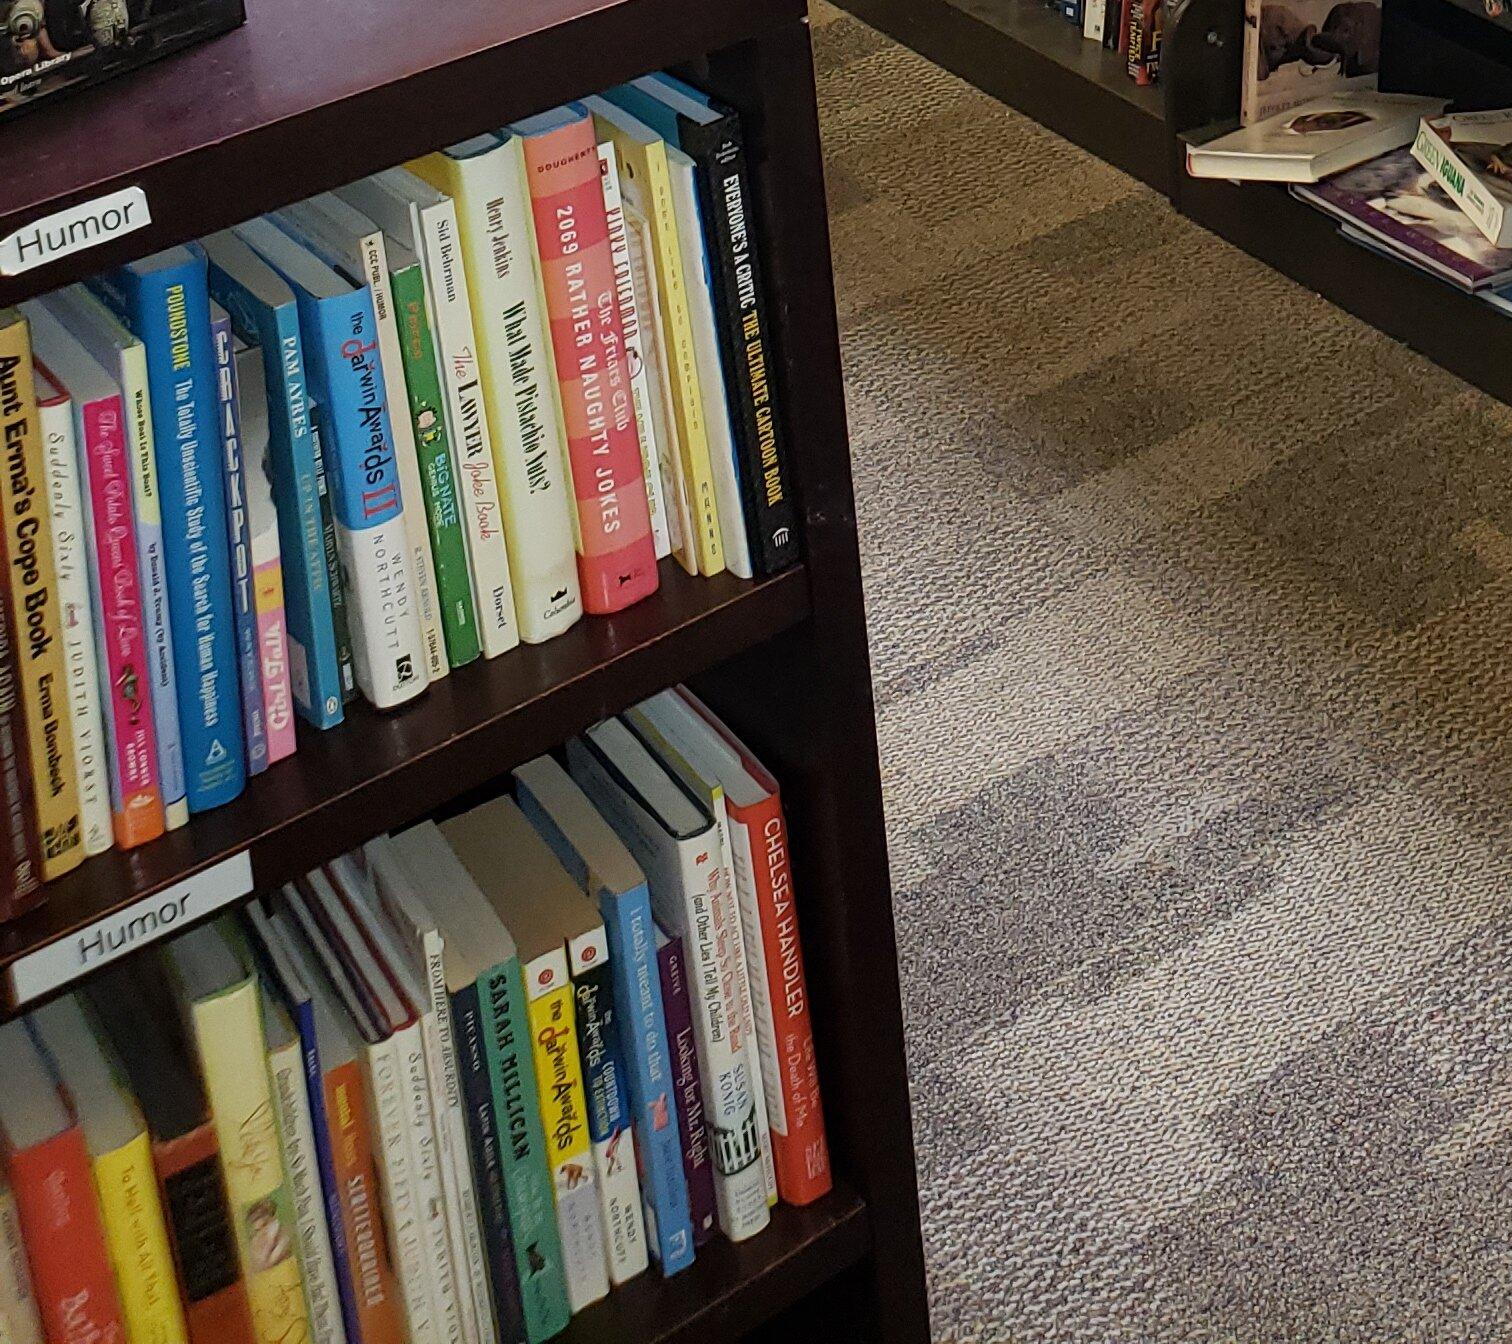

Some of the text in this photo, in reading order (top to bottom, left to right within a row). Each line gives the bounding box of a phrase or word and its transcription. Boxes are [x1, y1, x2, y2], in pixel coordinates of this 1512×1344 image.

[537, 145, 597, 173] DOUGHERTY
[1440, 158, 1466, 196] IGUANA
[16, 201, 134, 263] Humor
[723, 174, 746, 252] EVERYONE'S
[437, 219, 457, 304] Sid Behrman
[738, 264, 757, 309] CRITIC
[166, 284, 191, 372] POUNDSTONE
[744, 310, 760, 338] THE
[284, 336, 308, 438] PAM AYRES
[556, 205, 620, 534] 2069 RATHER NAUGHTY JOKES
[747, 338, 771, 403] ULTIMATE
[457, 378, 491, 542] LAWYER Joke Book
[515, 384, 552, 496] Pistachio Nuts?
[757, 404, 780, 466] CARTOON
[0, 355, 53, 659] Aunt Erma's Cope Book
[767, 468, 784, 507] BOOK
[44, 716, 66, 798] Bombeck
[78, 892, 192, 965] Humor
[762, 817, 804, 1019] CHELSEA HANDLER
[488, 973, 530, 1162] SARAH MILLICAN
